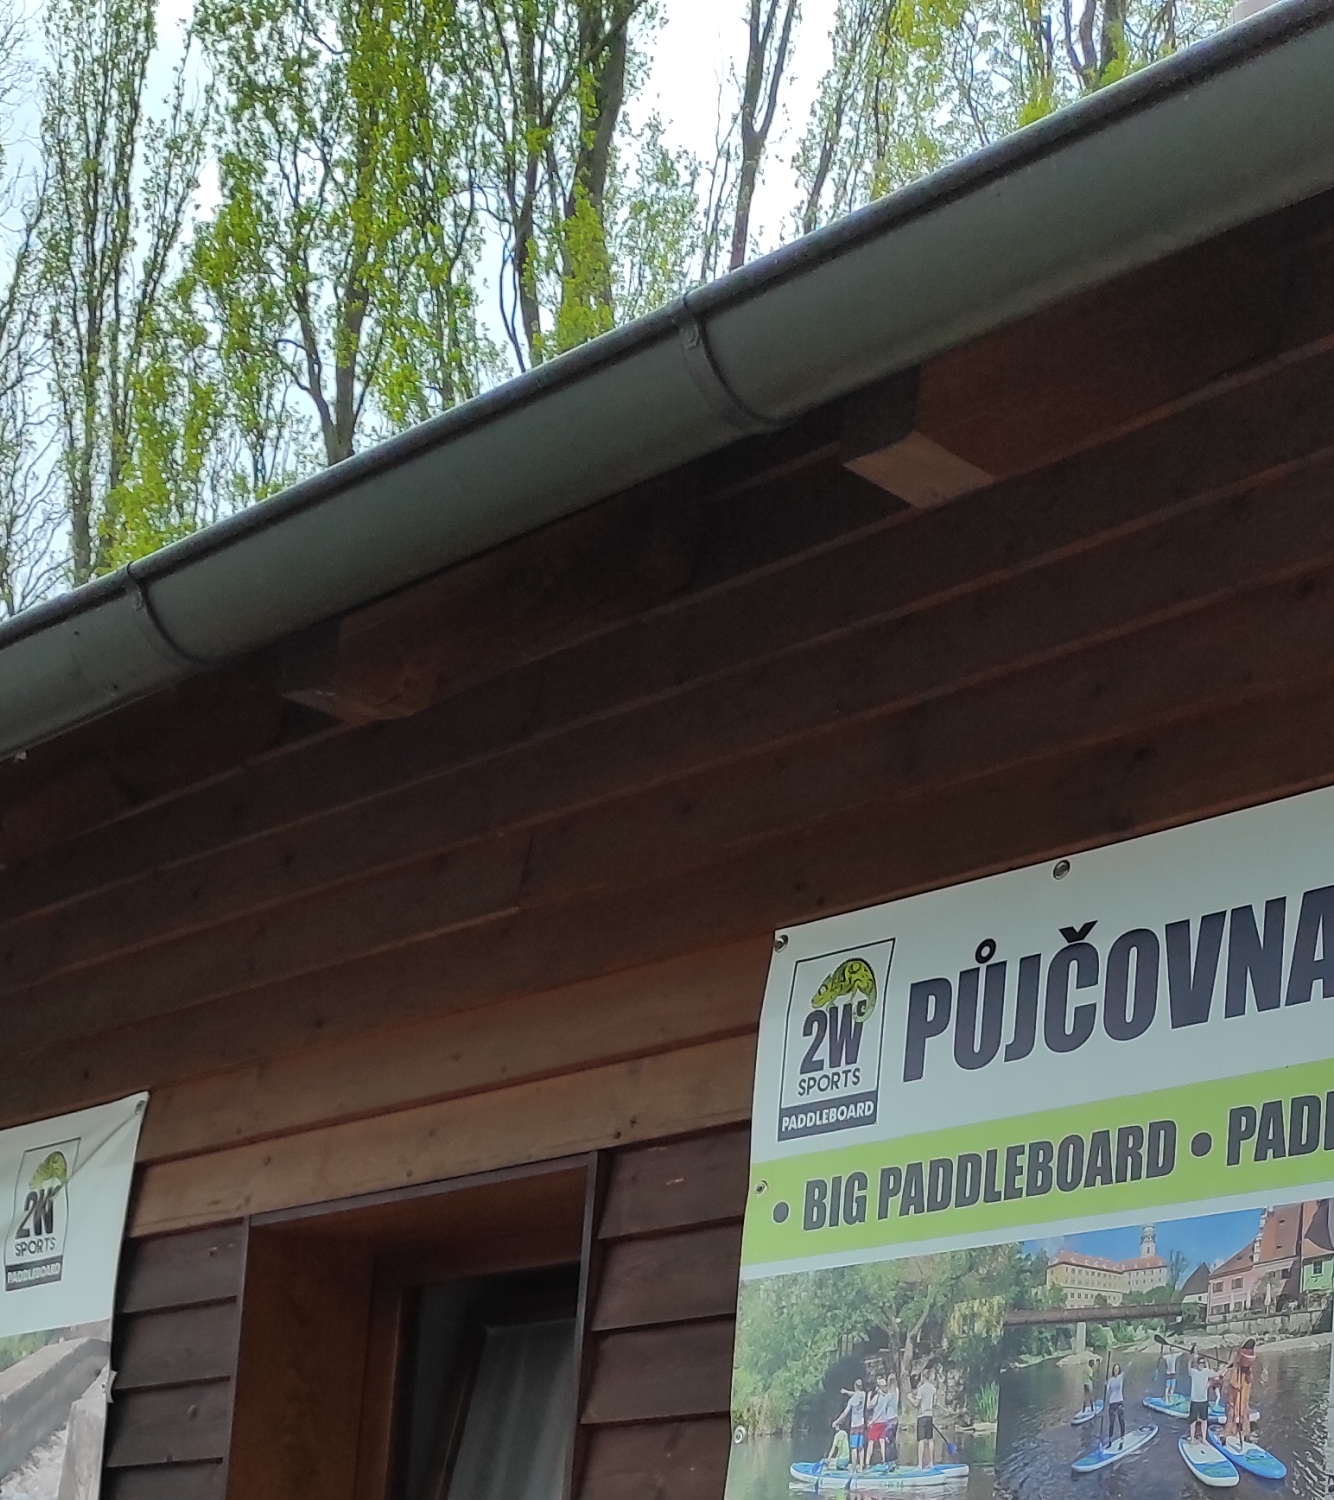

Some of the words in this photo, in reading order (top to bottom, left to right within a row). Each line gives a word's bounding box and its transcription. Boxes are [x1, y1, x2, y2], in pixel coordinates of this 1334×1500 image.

[799, 1000, 867, 1075] 2W
[797, 1067, 861, 1097] SPORTS
[781, 1100, 875, 1132] PADDLEBOARD
[802, 1171, 868, 1232] BIG
[876, 1120, 1177, 1222] PADDLEBOARD
[14, 1236, 57, 1257] SPORTS
